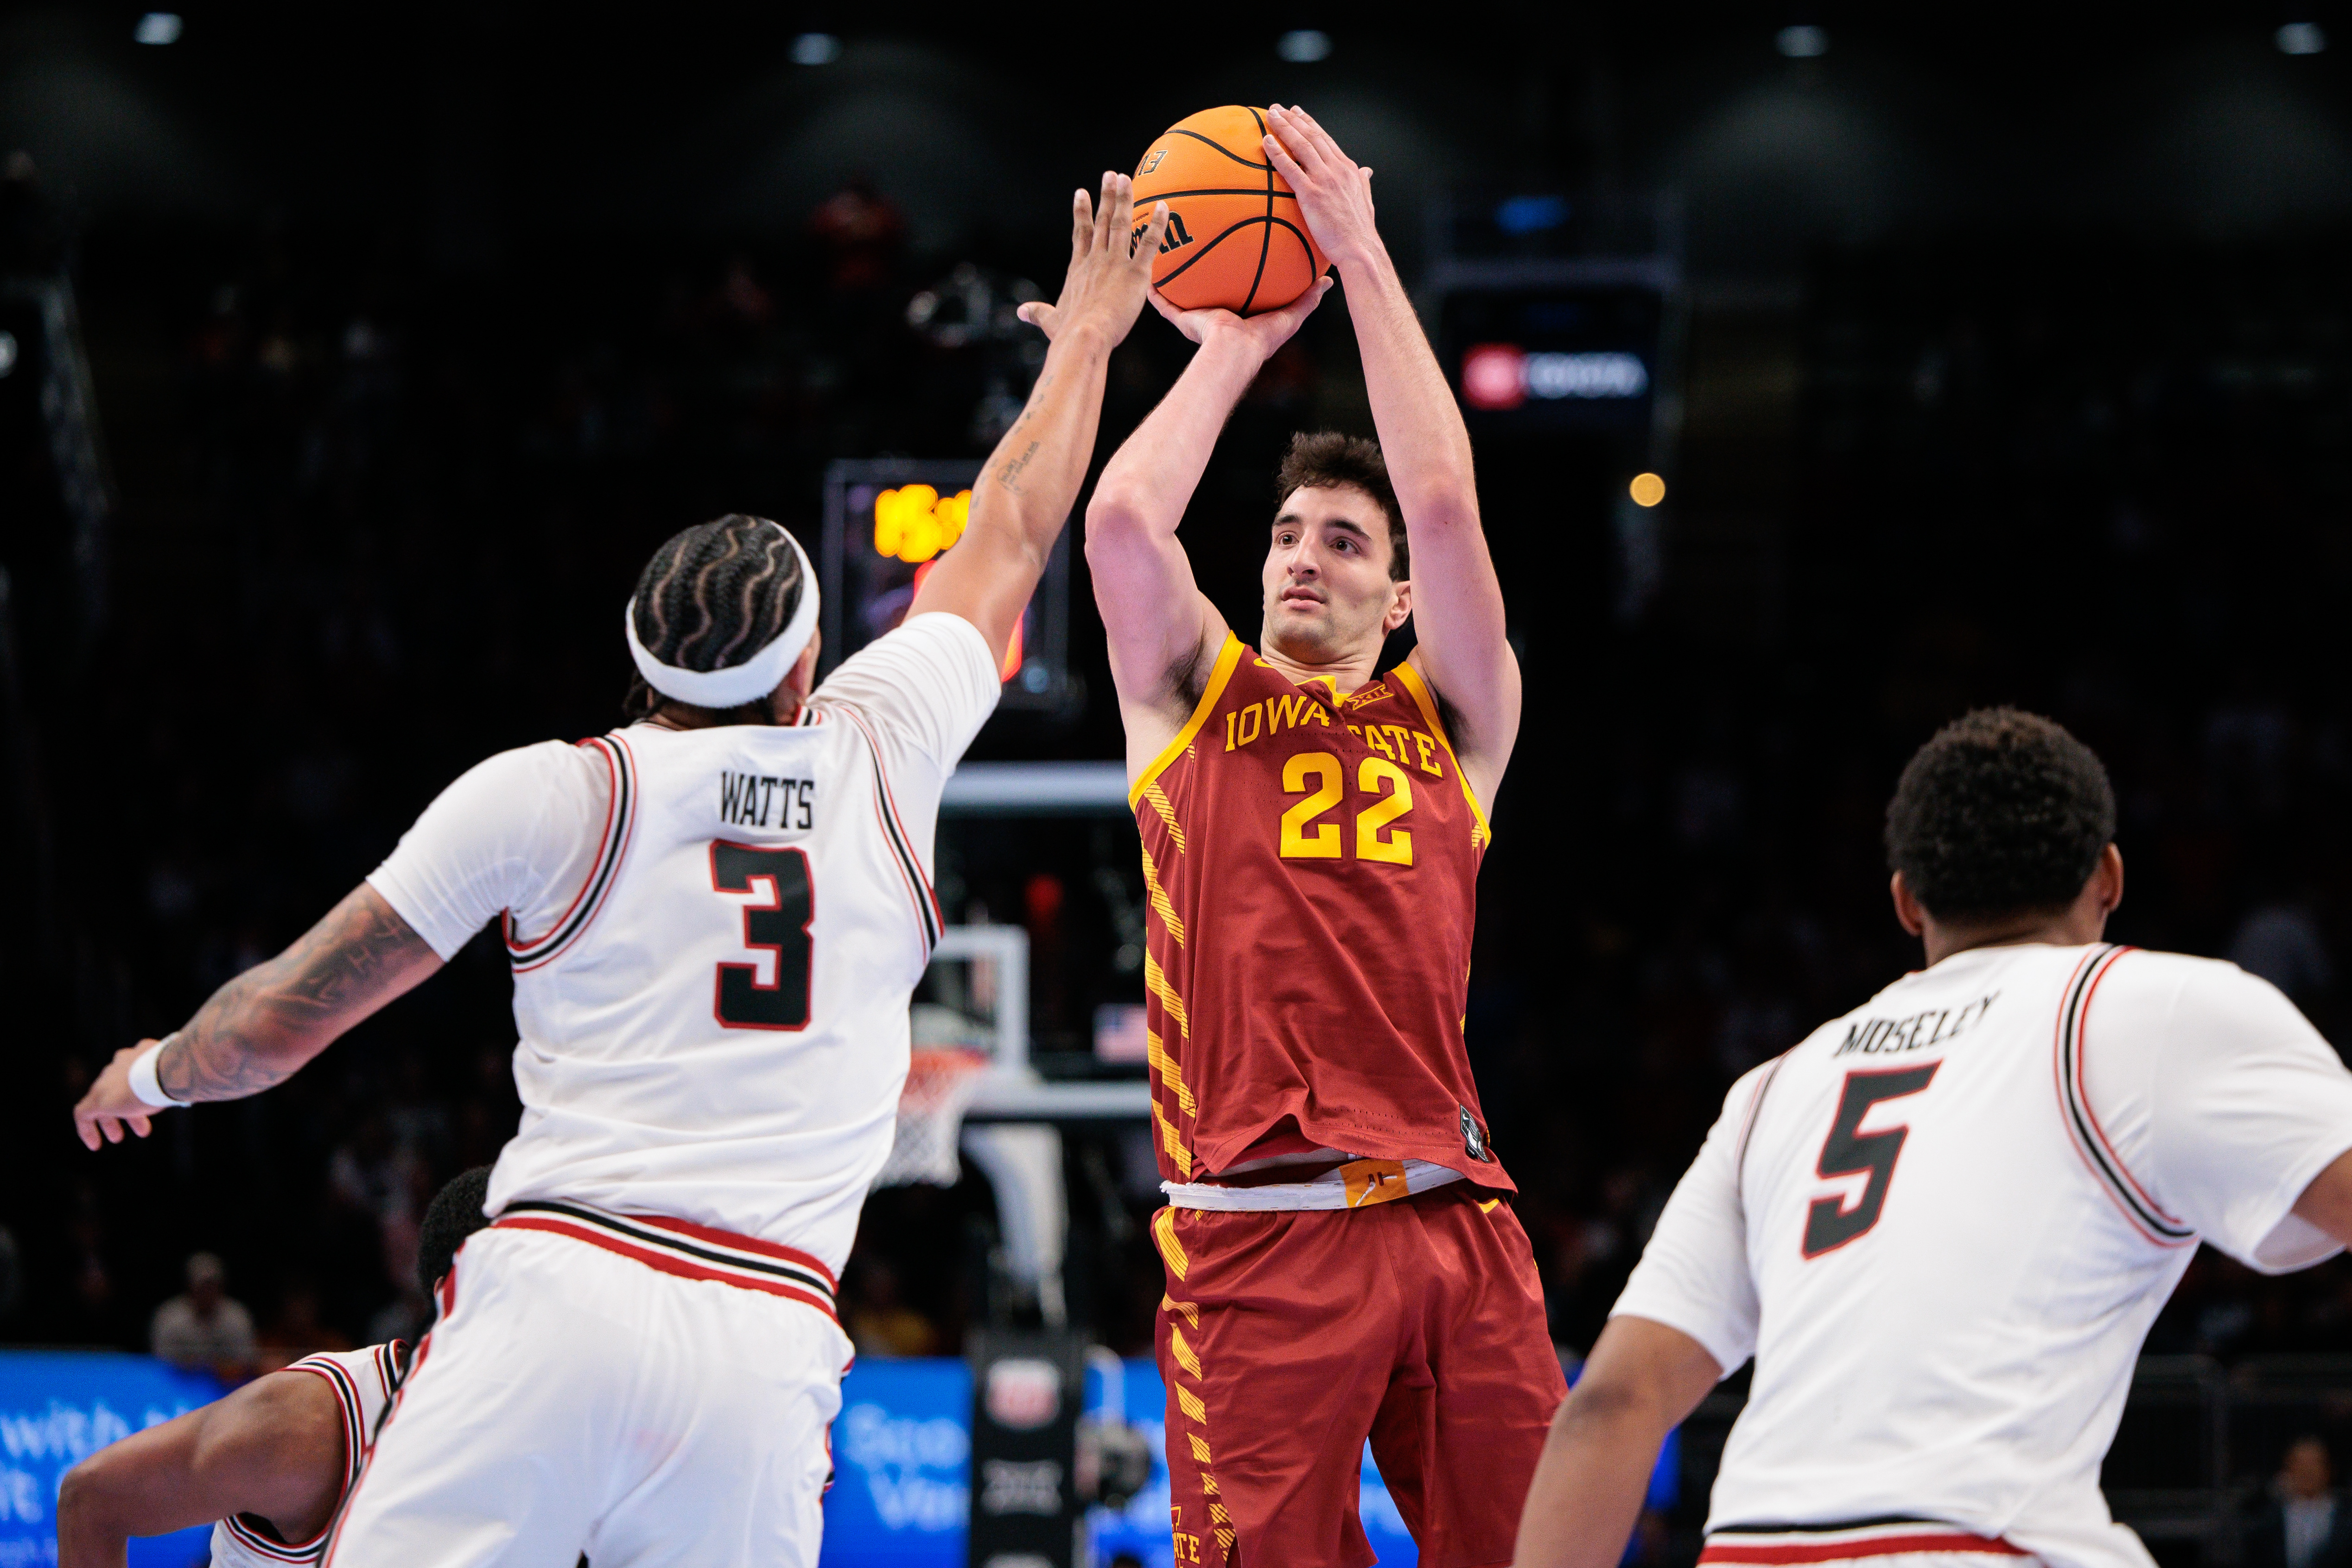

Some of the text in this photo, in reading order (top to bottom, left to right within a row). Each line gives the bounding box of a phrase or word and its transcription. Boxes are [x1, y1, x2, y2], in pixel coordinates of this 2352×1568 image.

[1225, 694, 1443, 778] IOWA ATE
[720, 770, 814, 830] WATTS
[1279, 751, 1413, 866] 22
[708, 838, 814, 1032] 3
[1832, 989, 2001, 1058] MOSELEY
[1800, 1059, 1944, 1261] 5
